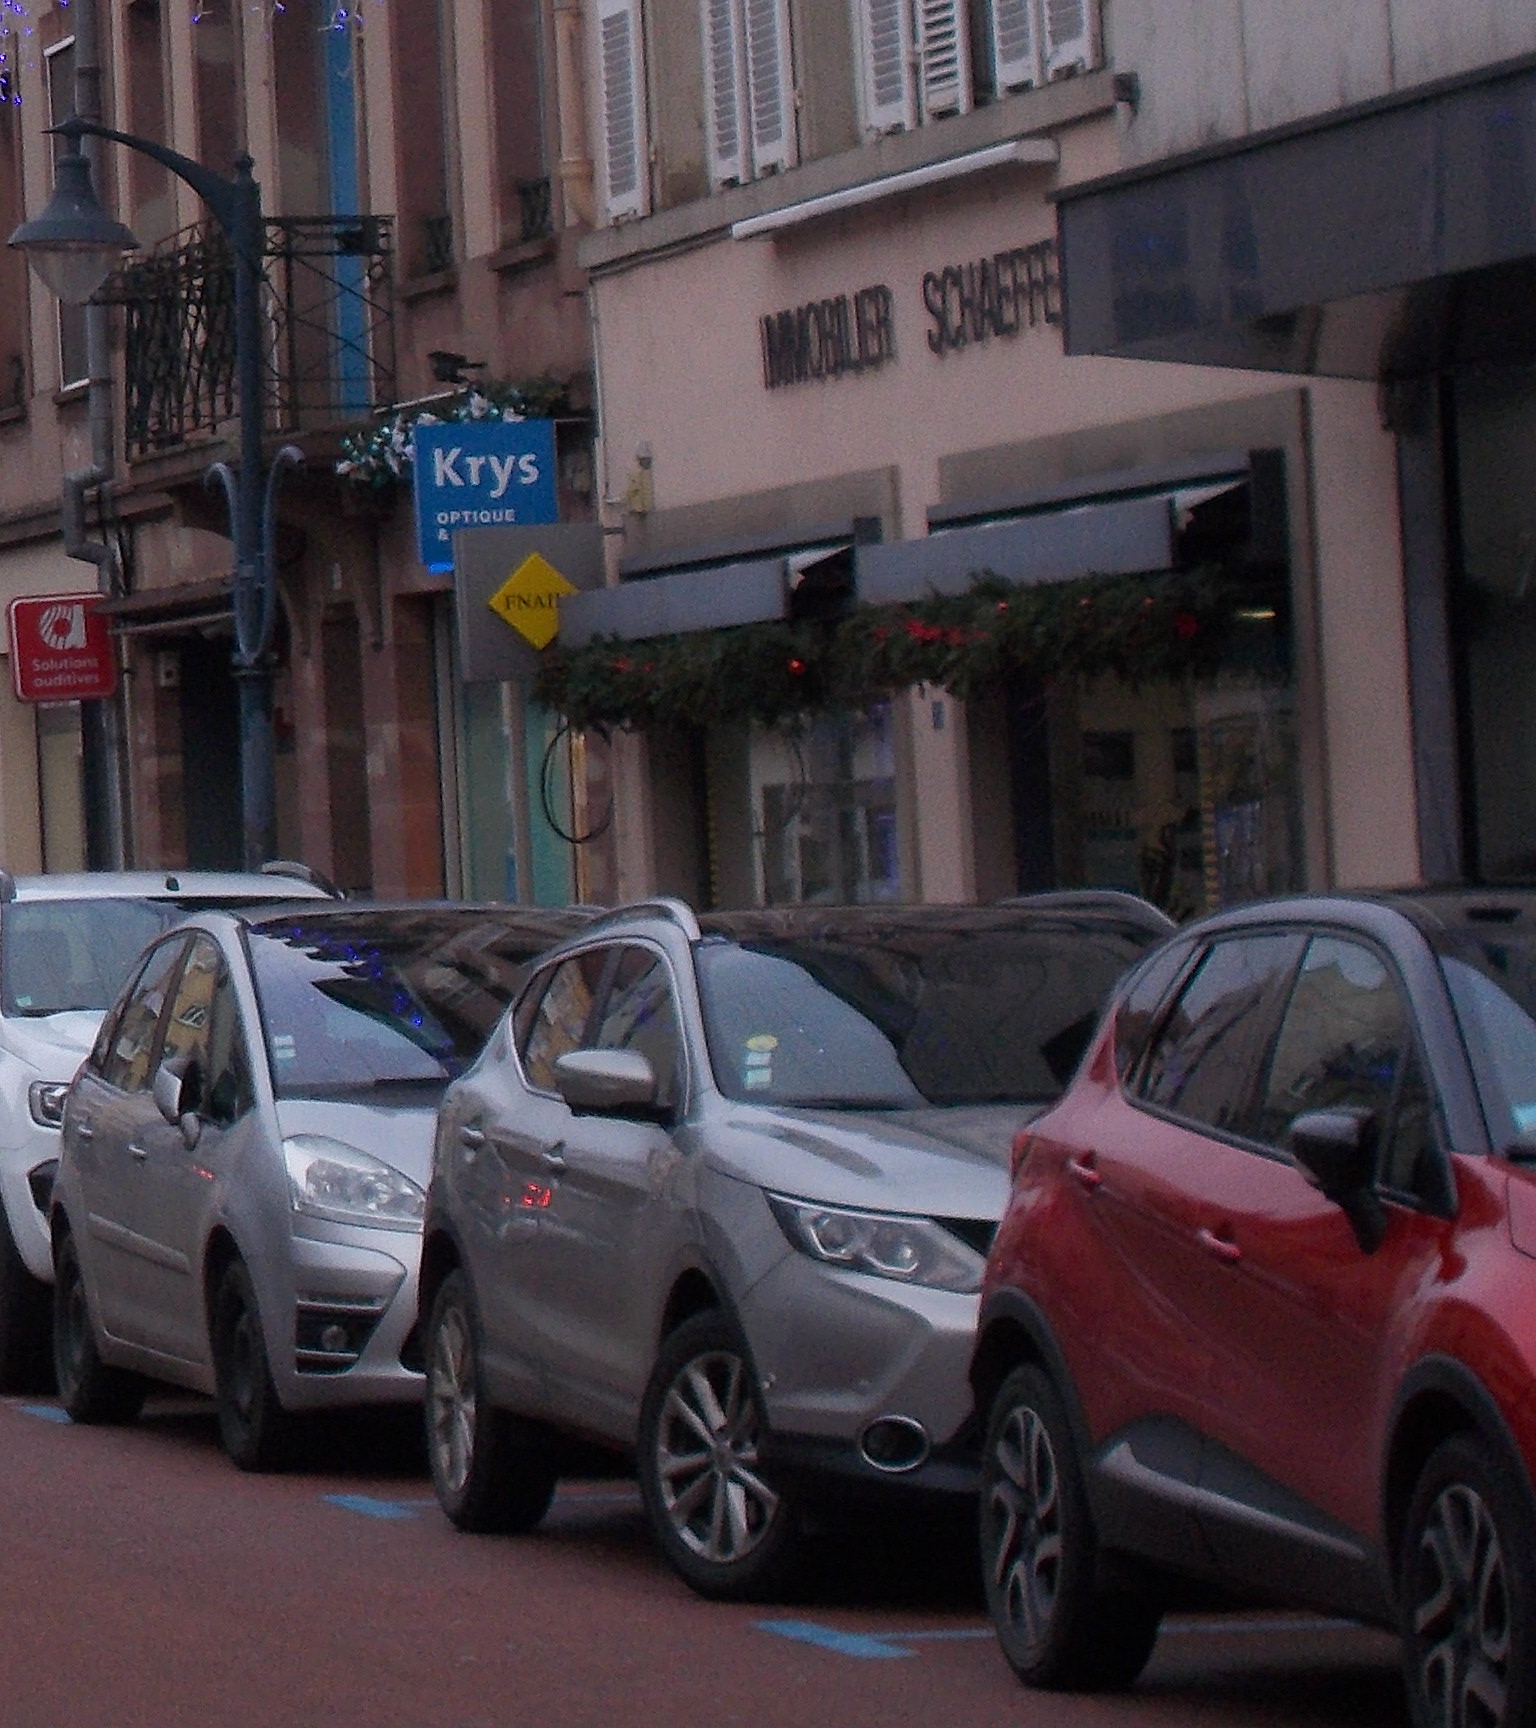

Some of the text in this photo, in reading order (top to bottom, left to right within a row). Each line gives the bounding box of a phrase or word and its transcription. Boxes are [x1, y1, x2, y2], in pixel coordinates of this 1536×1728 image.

[759, 238, 1061, 390] IMMOBILIER SCHAEFFE
[433, 446, 541, 499] Krys
[436, 508, 517, 526] OPTIQUE
[505, 592, 560, 611] FNAI
[34, 673, 100, 688] auditives
